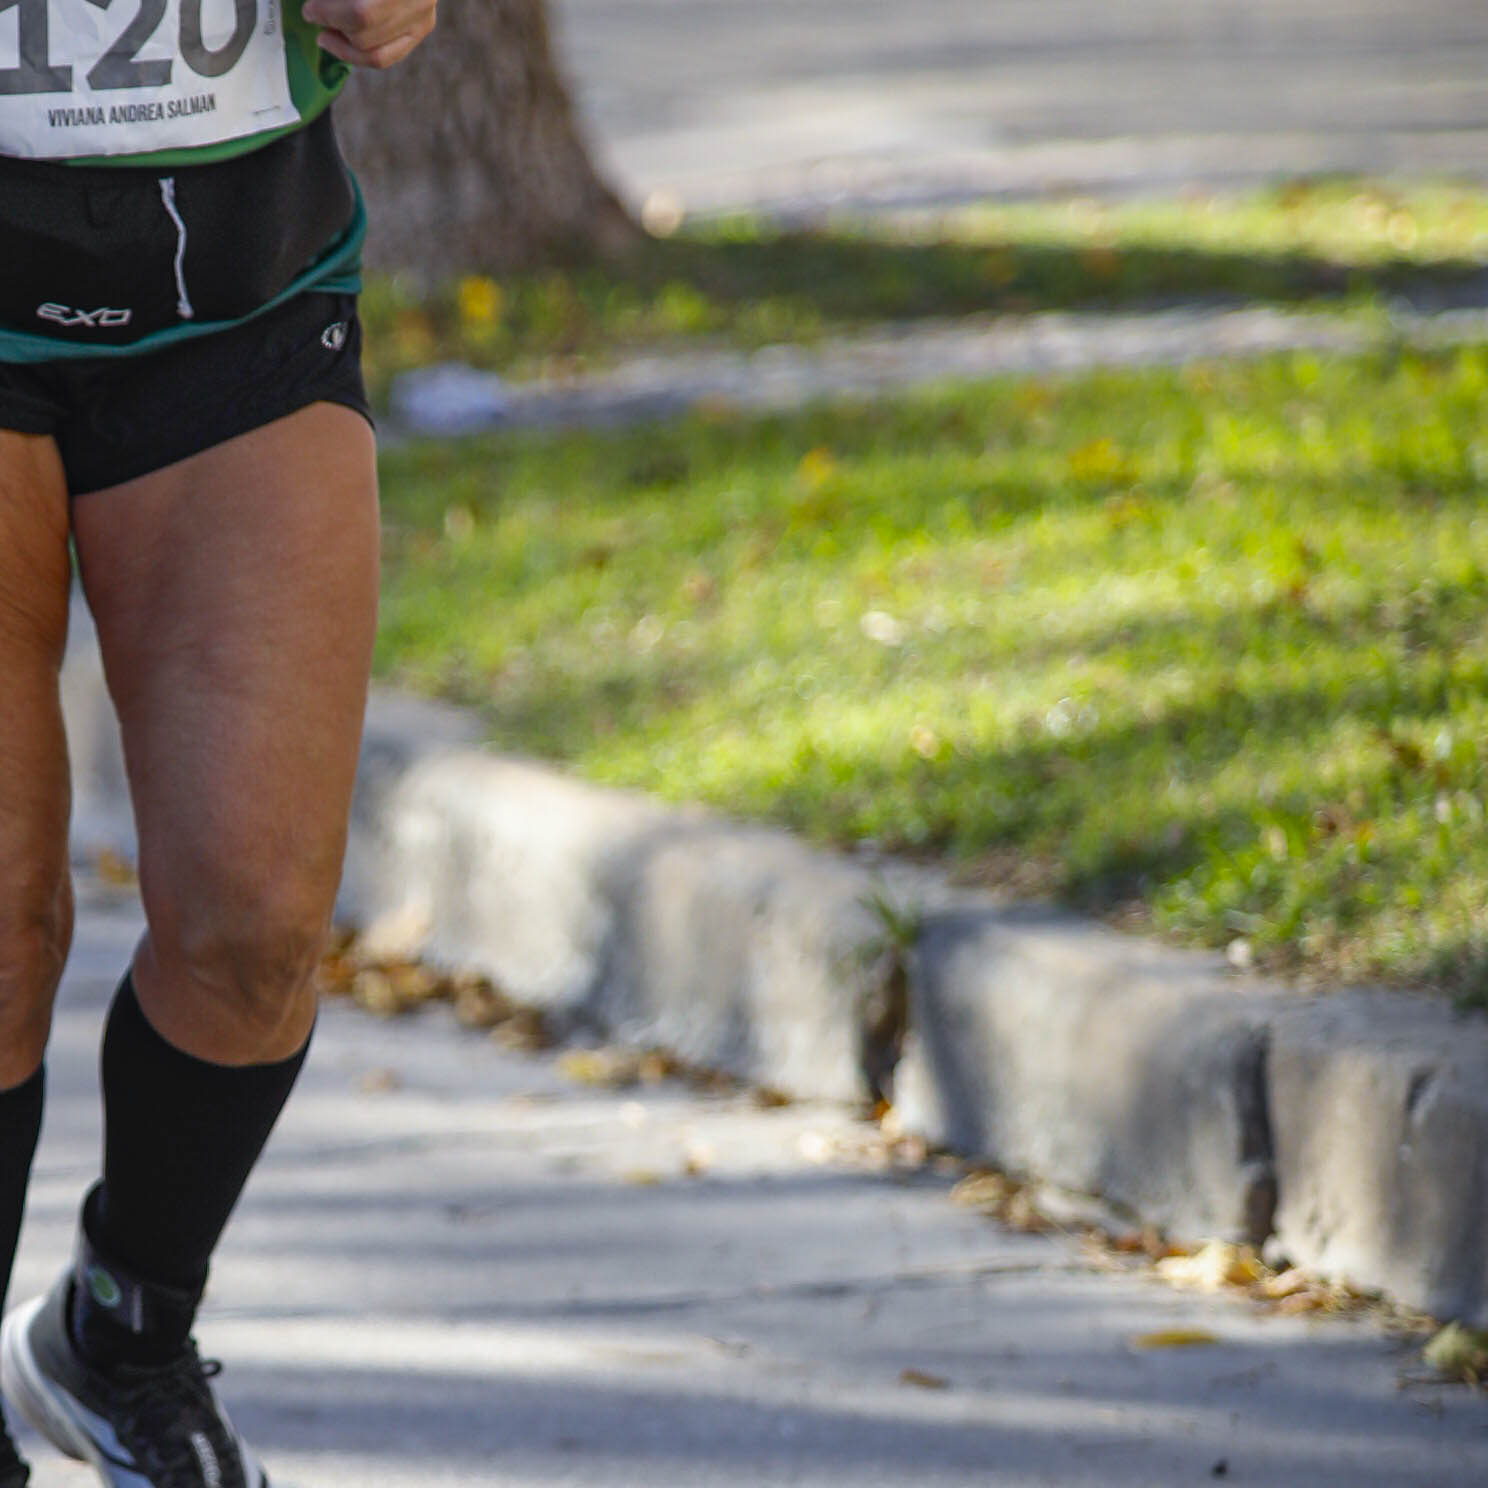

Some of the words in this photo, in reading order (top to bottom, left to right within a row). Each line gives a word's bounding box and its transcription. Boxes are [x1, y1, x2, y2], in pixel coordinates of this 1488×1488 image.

[48, 106, 105, 128] VIVIANA
[109, 101, 164, 124] ANDREA
[167, 93, 216, 119] SALMAN
